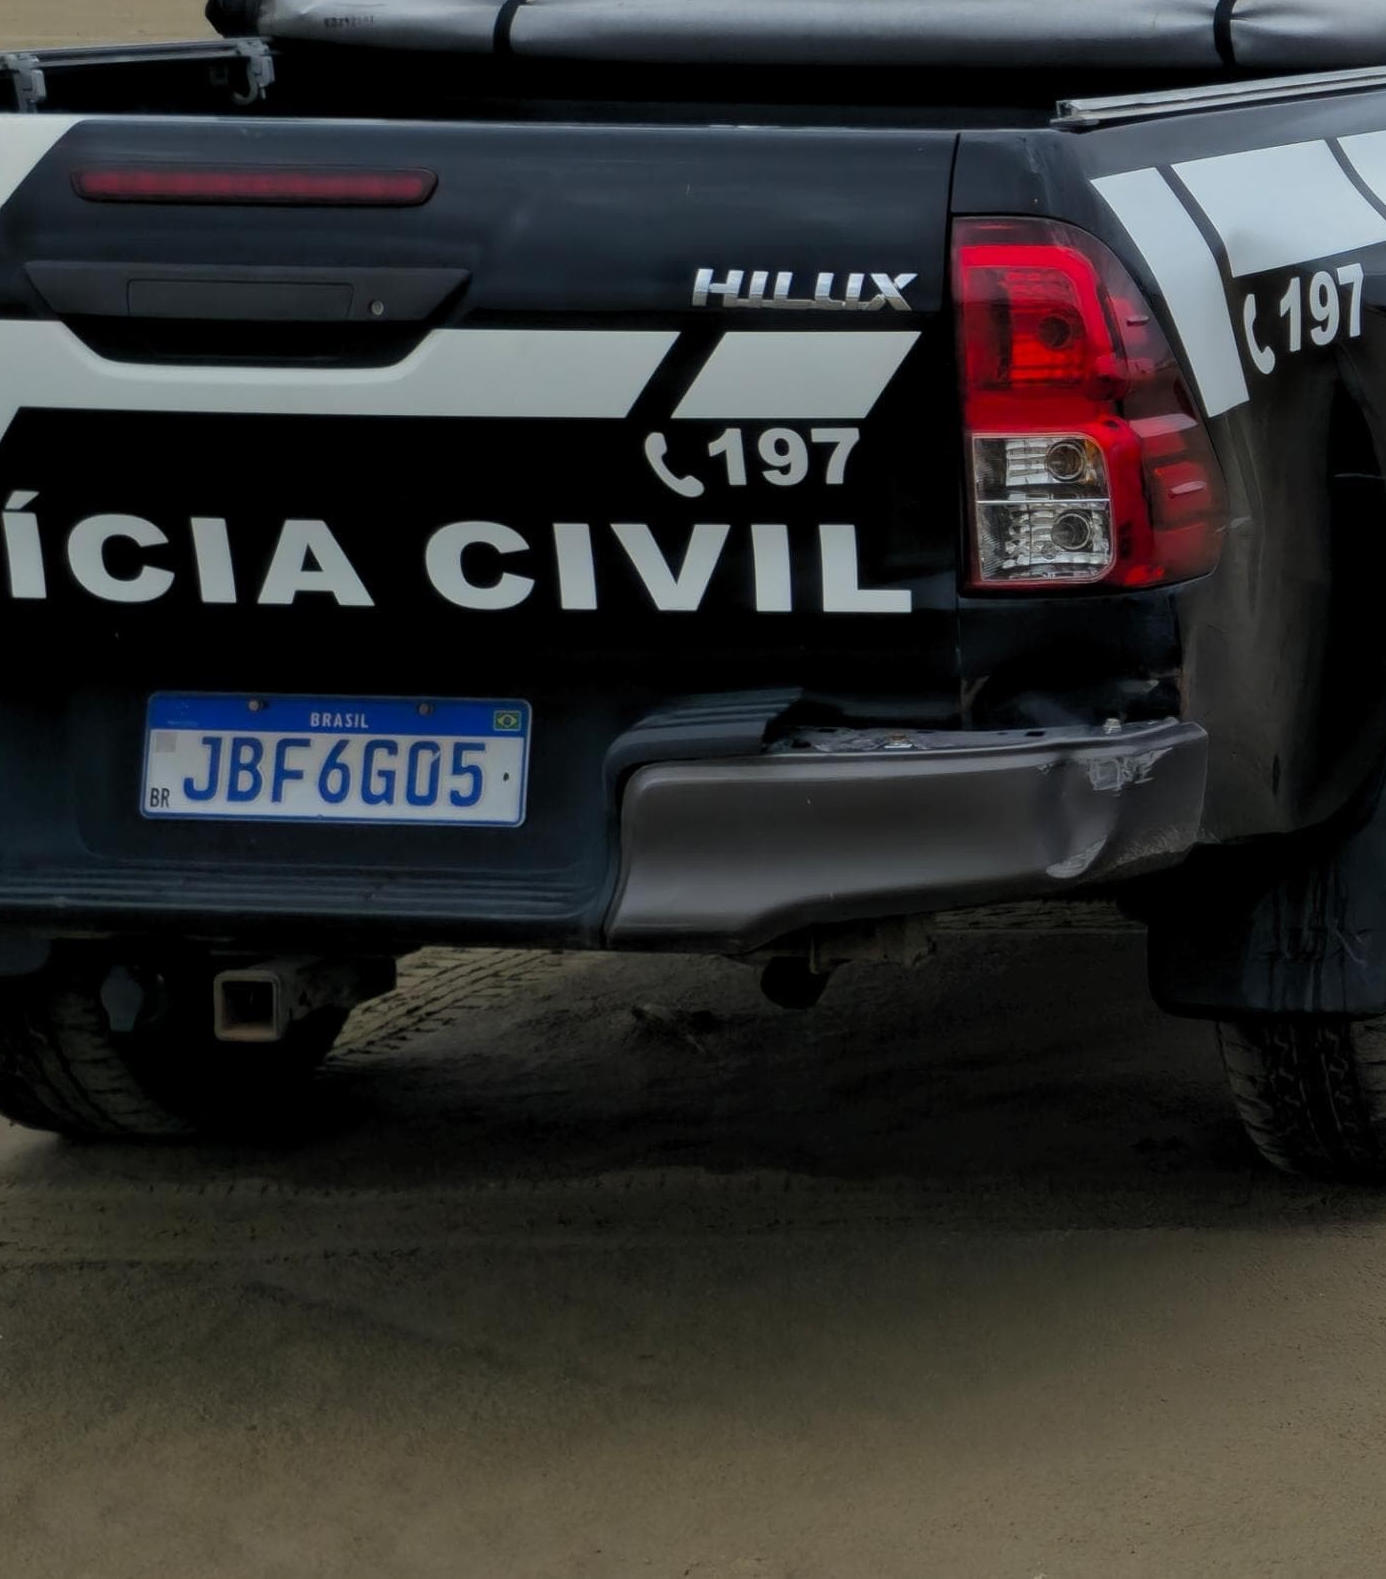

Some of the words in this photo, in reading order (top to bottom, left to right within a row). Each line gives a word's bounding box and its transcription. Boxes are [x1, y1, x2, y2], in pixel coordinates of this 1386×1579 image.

[692, 268, 917, 310] HILUX
[1279, 263, 1364, 352] 197
[708, 428, 860, 486] 197
[425, 521, 912, 613] CIVIL
[310, 713, 369, 729] BRASIL
[150, 787, 170, 808] BR
[183, 736, 486, 807] JBF6G05
